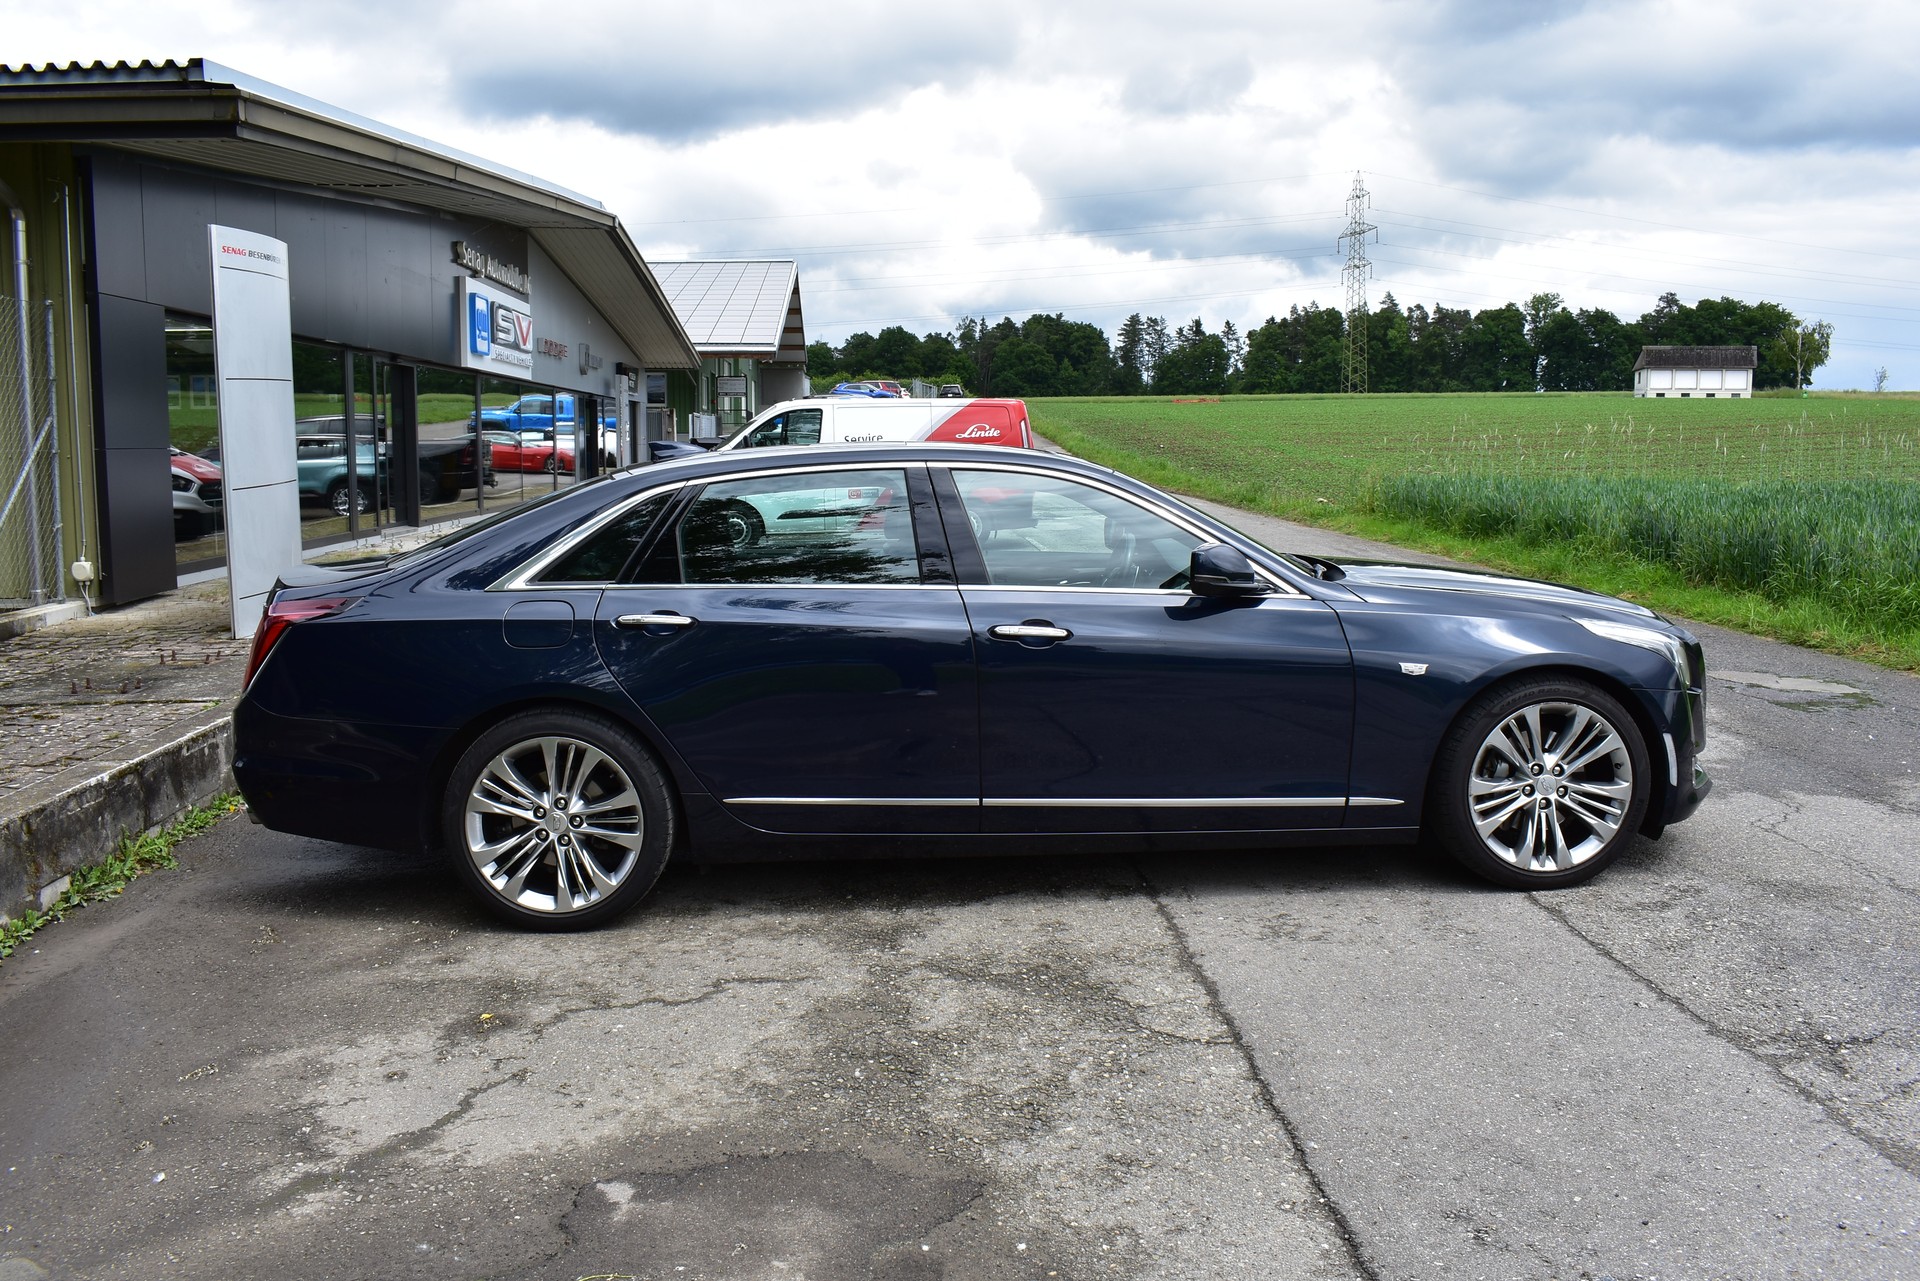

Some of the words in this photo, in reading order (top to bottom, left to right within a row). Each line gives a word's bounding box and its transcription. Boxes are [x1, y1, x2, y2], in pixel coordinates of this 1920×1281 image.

[221, 245, 247, 257] SENAG
[459, 240, 485, 278] Senag
[955, 423, 1001, 439] Linde
